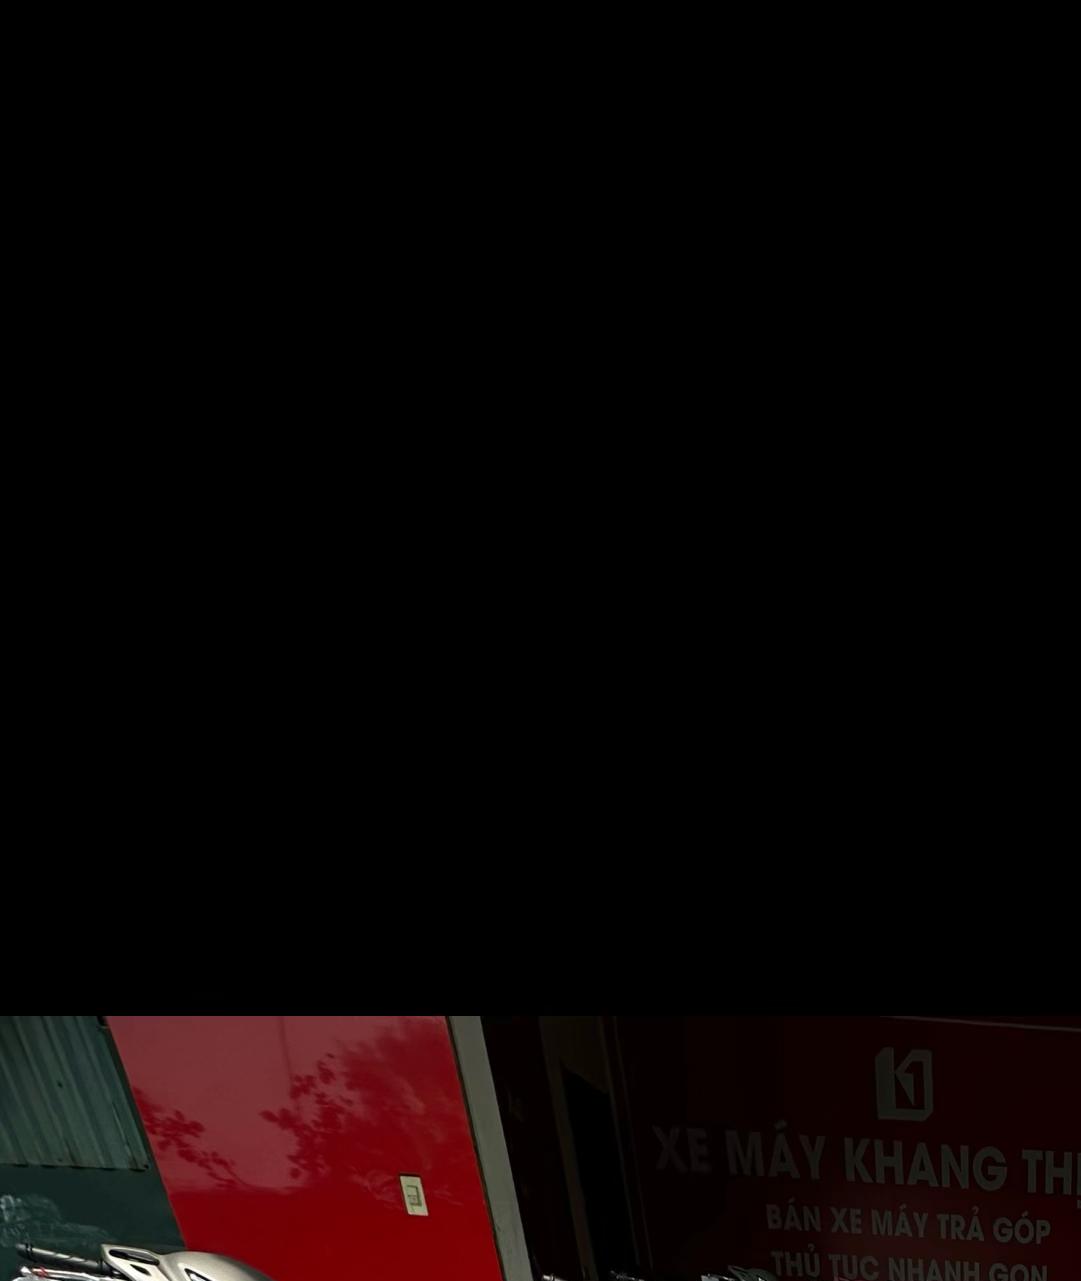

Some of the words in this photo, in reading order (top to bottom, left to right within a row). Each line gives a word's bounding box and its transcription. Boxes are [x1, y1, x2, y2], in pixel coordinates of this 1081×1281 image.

[651, 1124, 712, 1176] XE
[724, 1117, 826, 1181] MÁY
[843, 1135, 1009, 1192] KHANG
[765, 1197, 822, 1233] BÁN
[829, 1206, 863, 1235] XE
[871, 1203, 929, 1239] MÁY
[935, 1204, 985, 1242] TRẢ
[992, 1209, 1052, 1245] GÓP
[770, 1242, 821, 1278] THỦ
